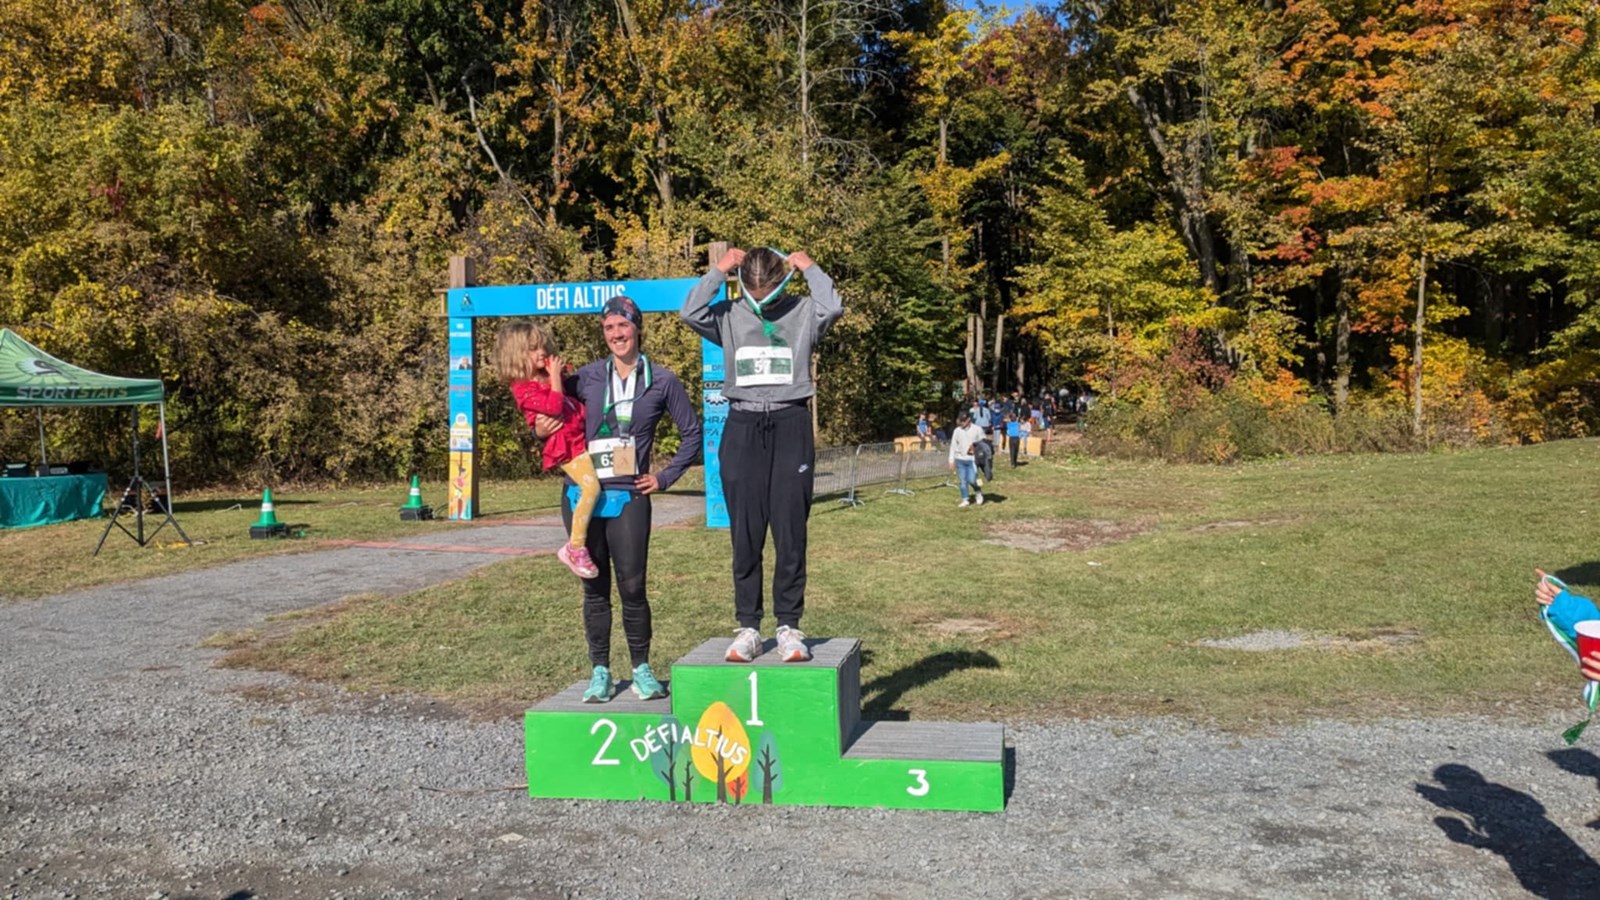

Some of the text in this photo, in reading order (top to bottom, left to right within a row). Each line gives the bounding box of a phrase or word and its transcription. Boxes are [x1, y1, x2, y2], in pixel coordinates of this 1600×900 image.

[536, 284, 569, 310] DÉFI
[16, 386, 128, 400] SPORTSTATS
[746, 671, 764, 726] 1
[590, 718, 620, 765] 2
[630, 723, 748, 765] DÉFI ALTIUS
[906, 769, 929, 796] 3
